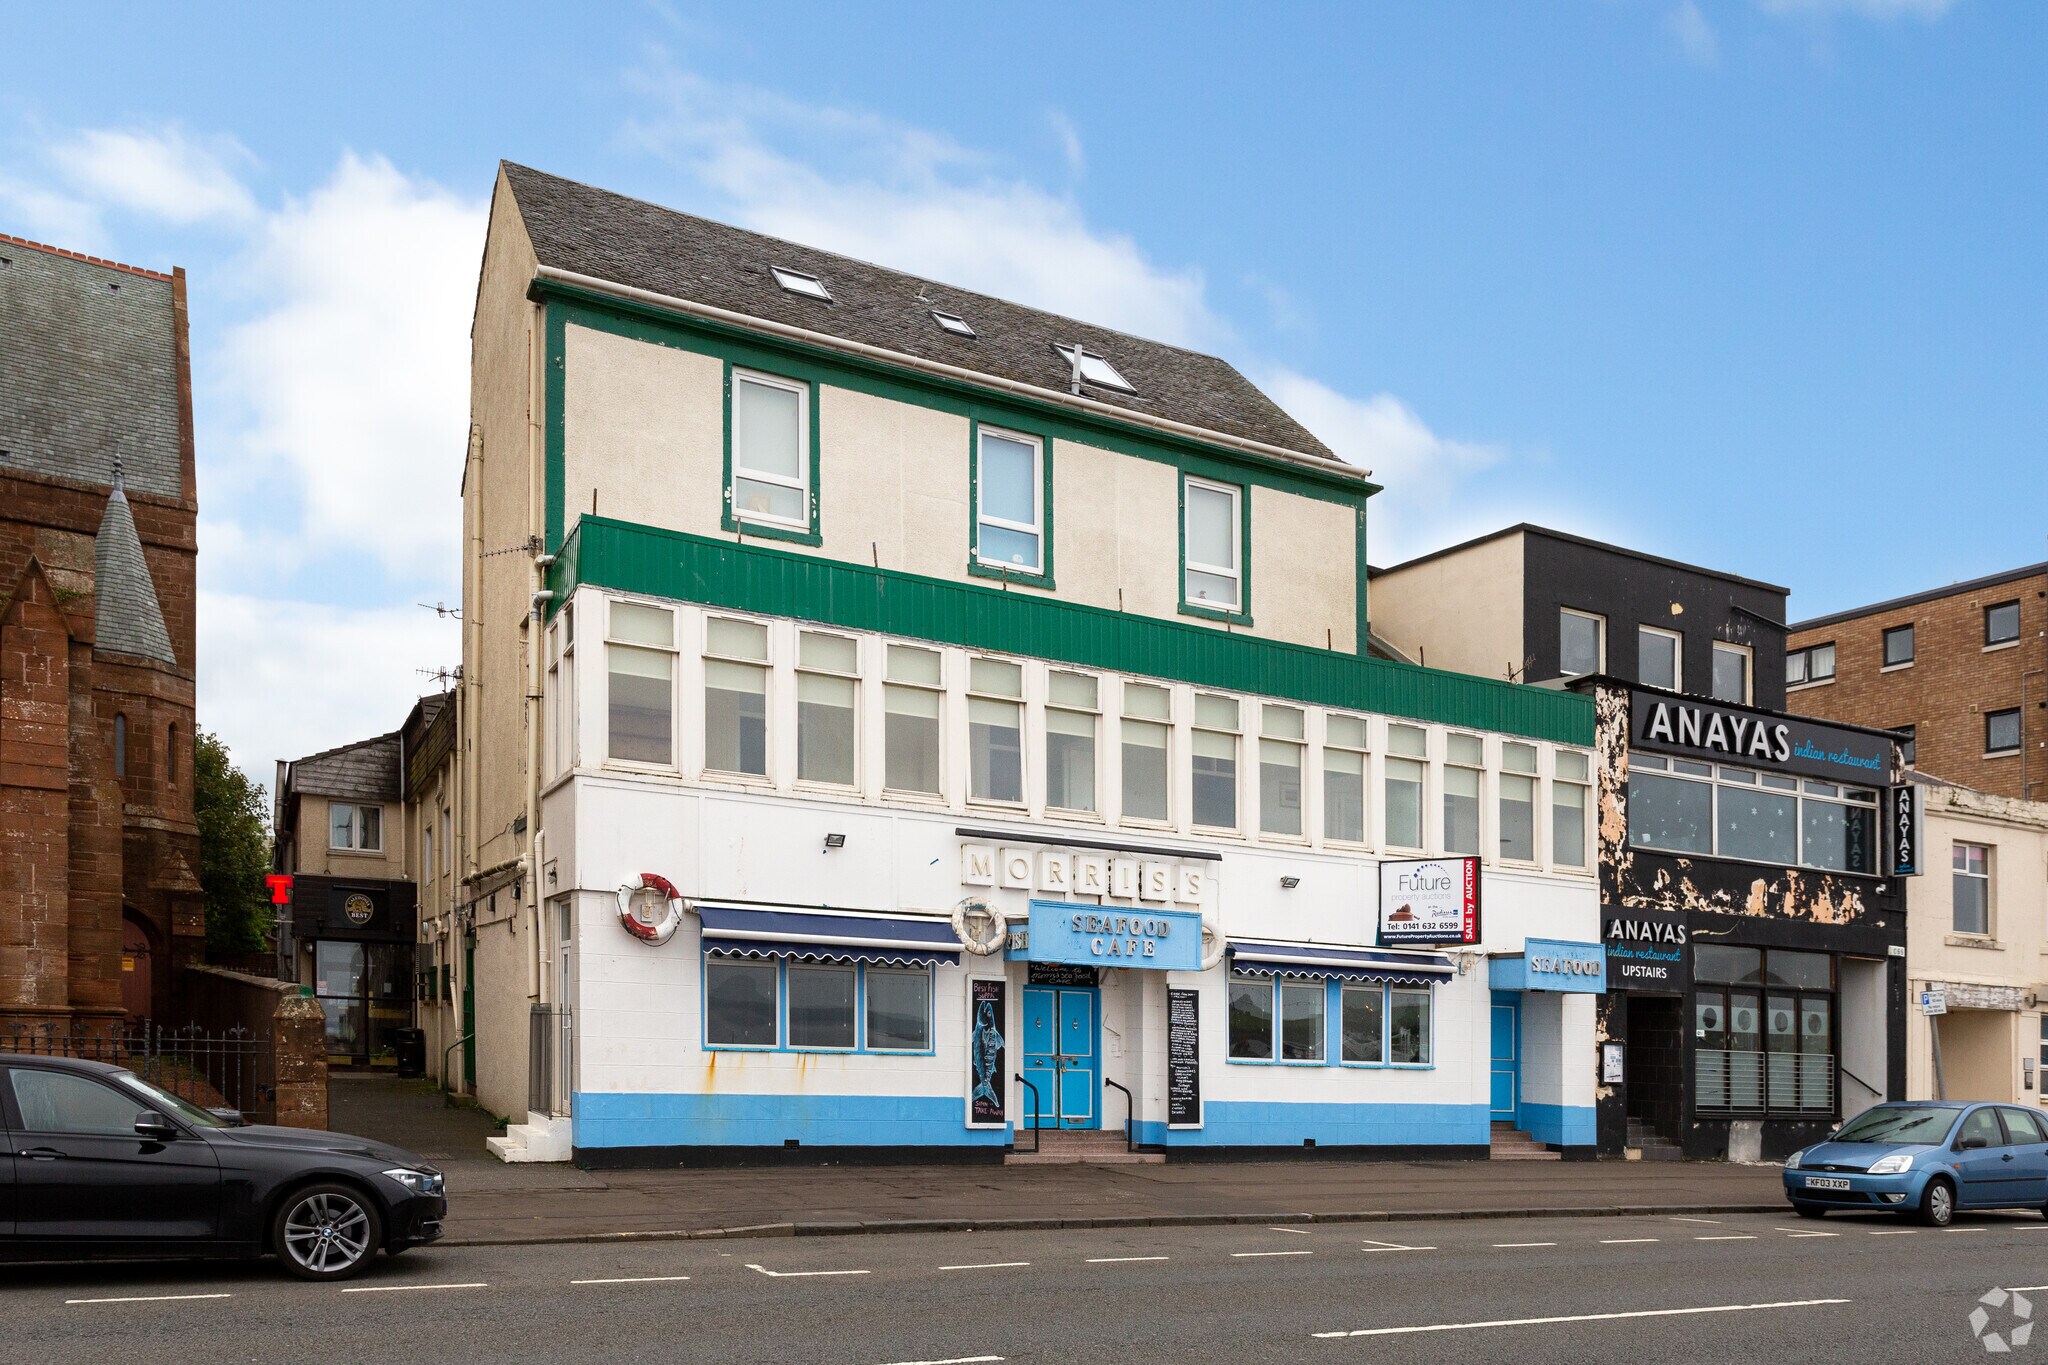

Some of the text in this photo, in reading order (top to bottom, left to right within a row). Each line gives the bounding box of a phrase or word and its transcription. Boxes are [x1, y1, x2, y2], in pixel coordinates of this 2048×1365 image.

[1649, 702, 1790, 762] ANAYAS
[1793, 739, 1882, 771] indian restaurant
[1899, 789, 1911, 862] ANAYAS
[971, 853, 1200, 895] MORRIS'S
[1399, 874, 1451, 891] Future
[1465, 860, 1474, 940] SALE by AUCTION
[1071, 913, 1172, 938] SEAFOOD
[1402, 922, 1420, 930] 0141
[1422, 922, 1437, 930] 632
[1439, 922, 1459, 930] 6599
[1610, 919, 1687, 945] ANAYAS
[1090, 937, 1156, 957] CAFE
[1607, 942, 1681, 962] indian restaurant
[1531, 955, 1602, 976] SEAFOOD
[1622, 964, 1668, 979] UPSTAIRS
[1810, 1178, 1849, 1189] KF03 XXP
